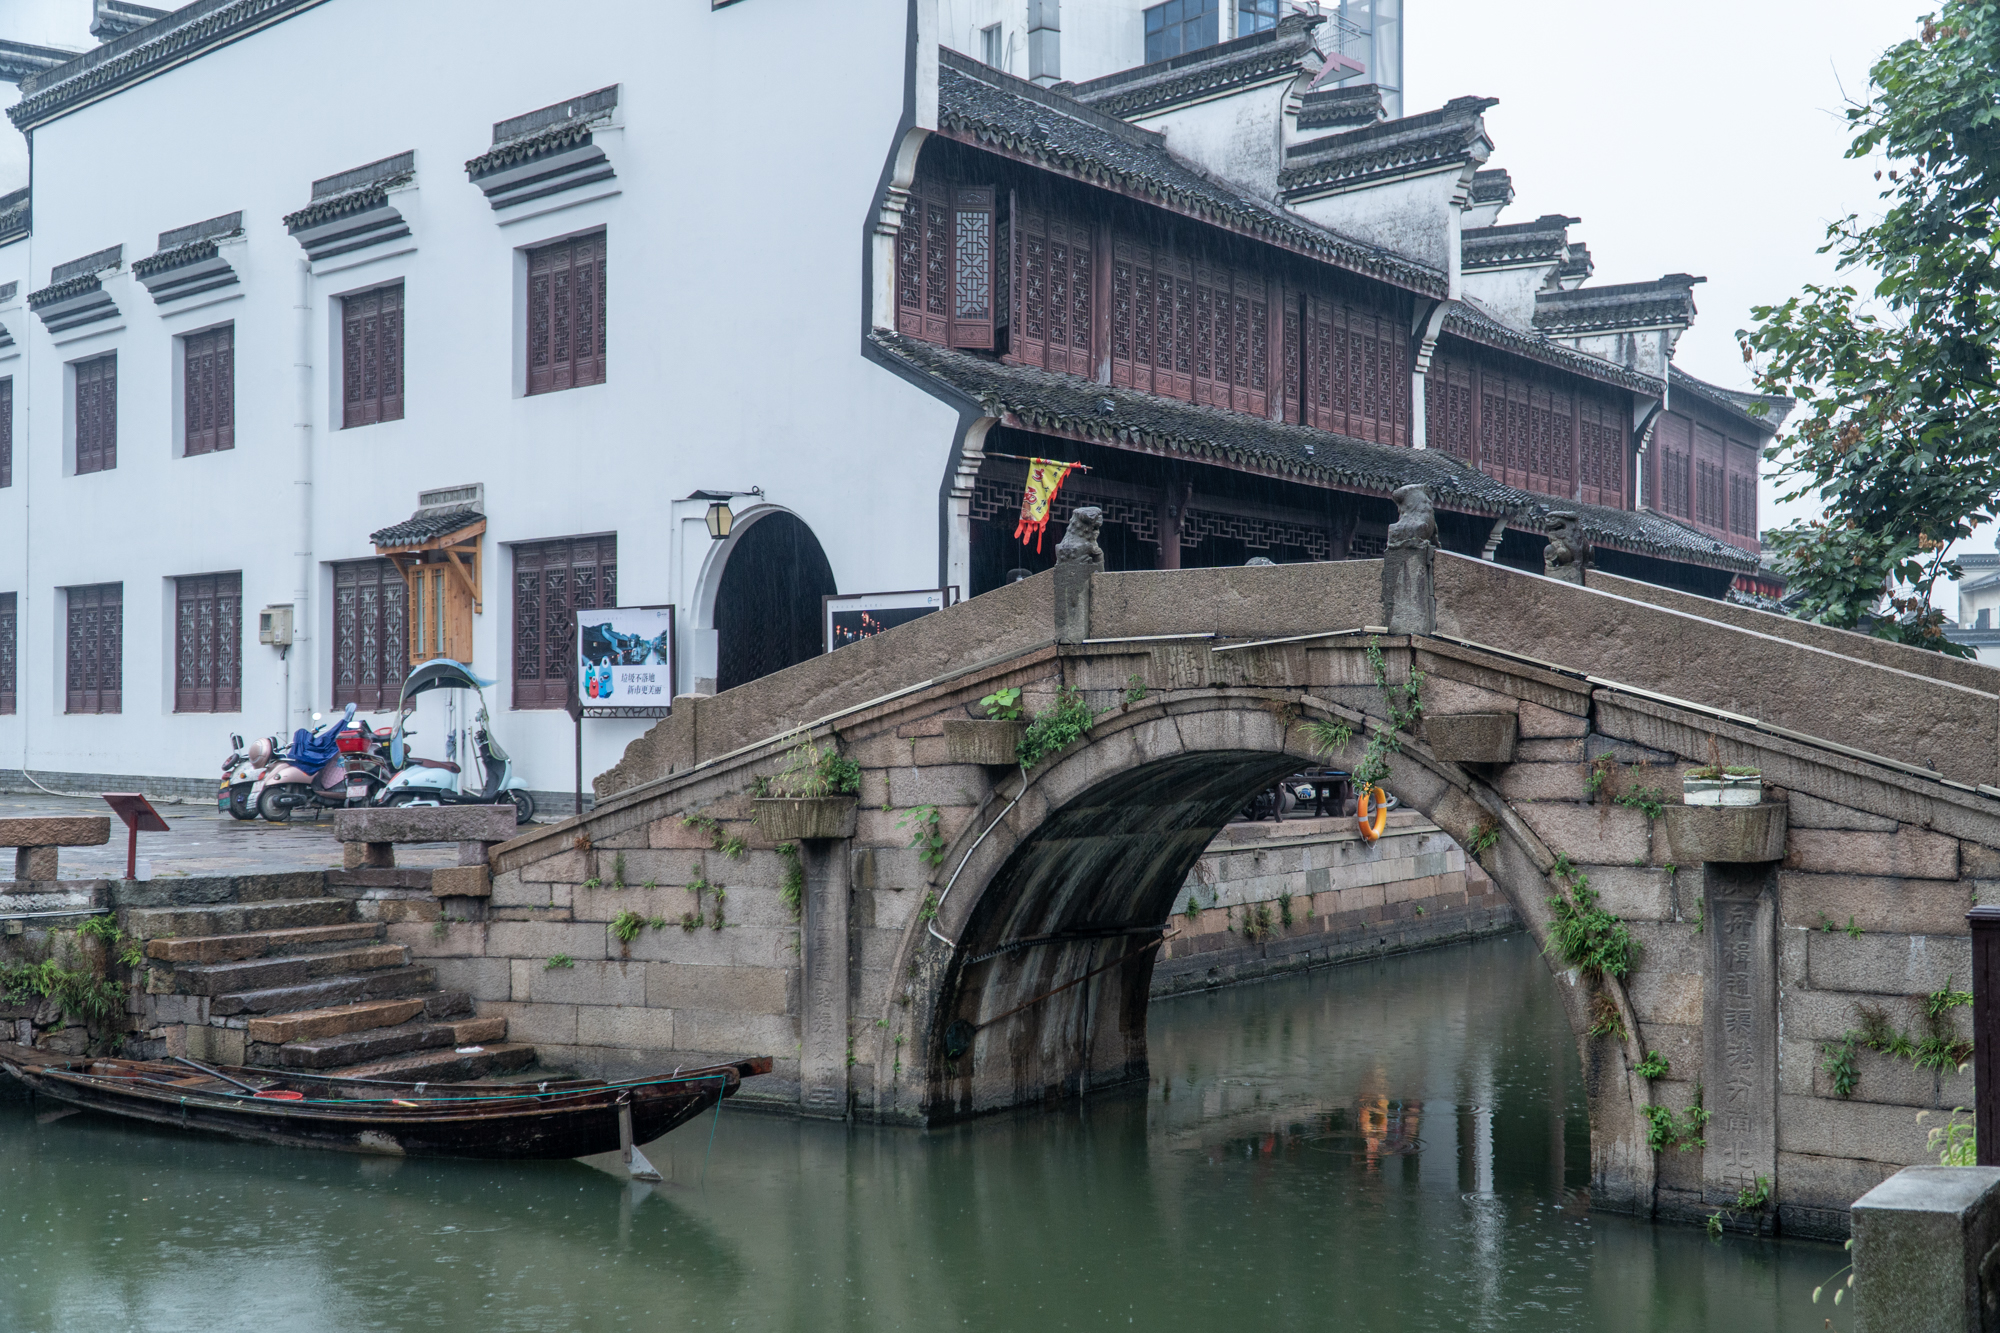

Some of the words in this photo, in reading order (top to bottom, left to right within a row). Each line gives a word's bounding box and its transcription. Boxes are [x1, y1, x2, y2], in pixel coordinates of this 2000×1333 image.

[622, 673, 656, 683] 垃圾不落地
[628, 685, 662, 695] 新市更美丽
